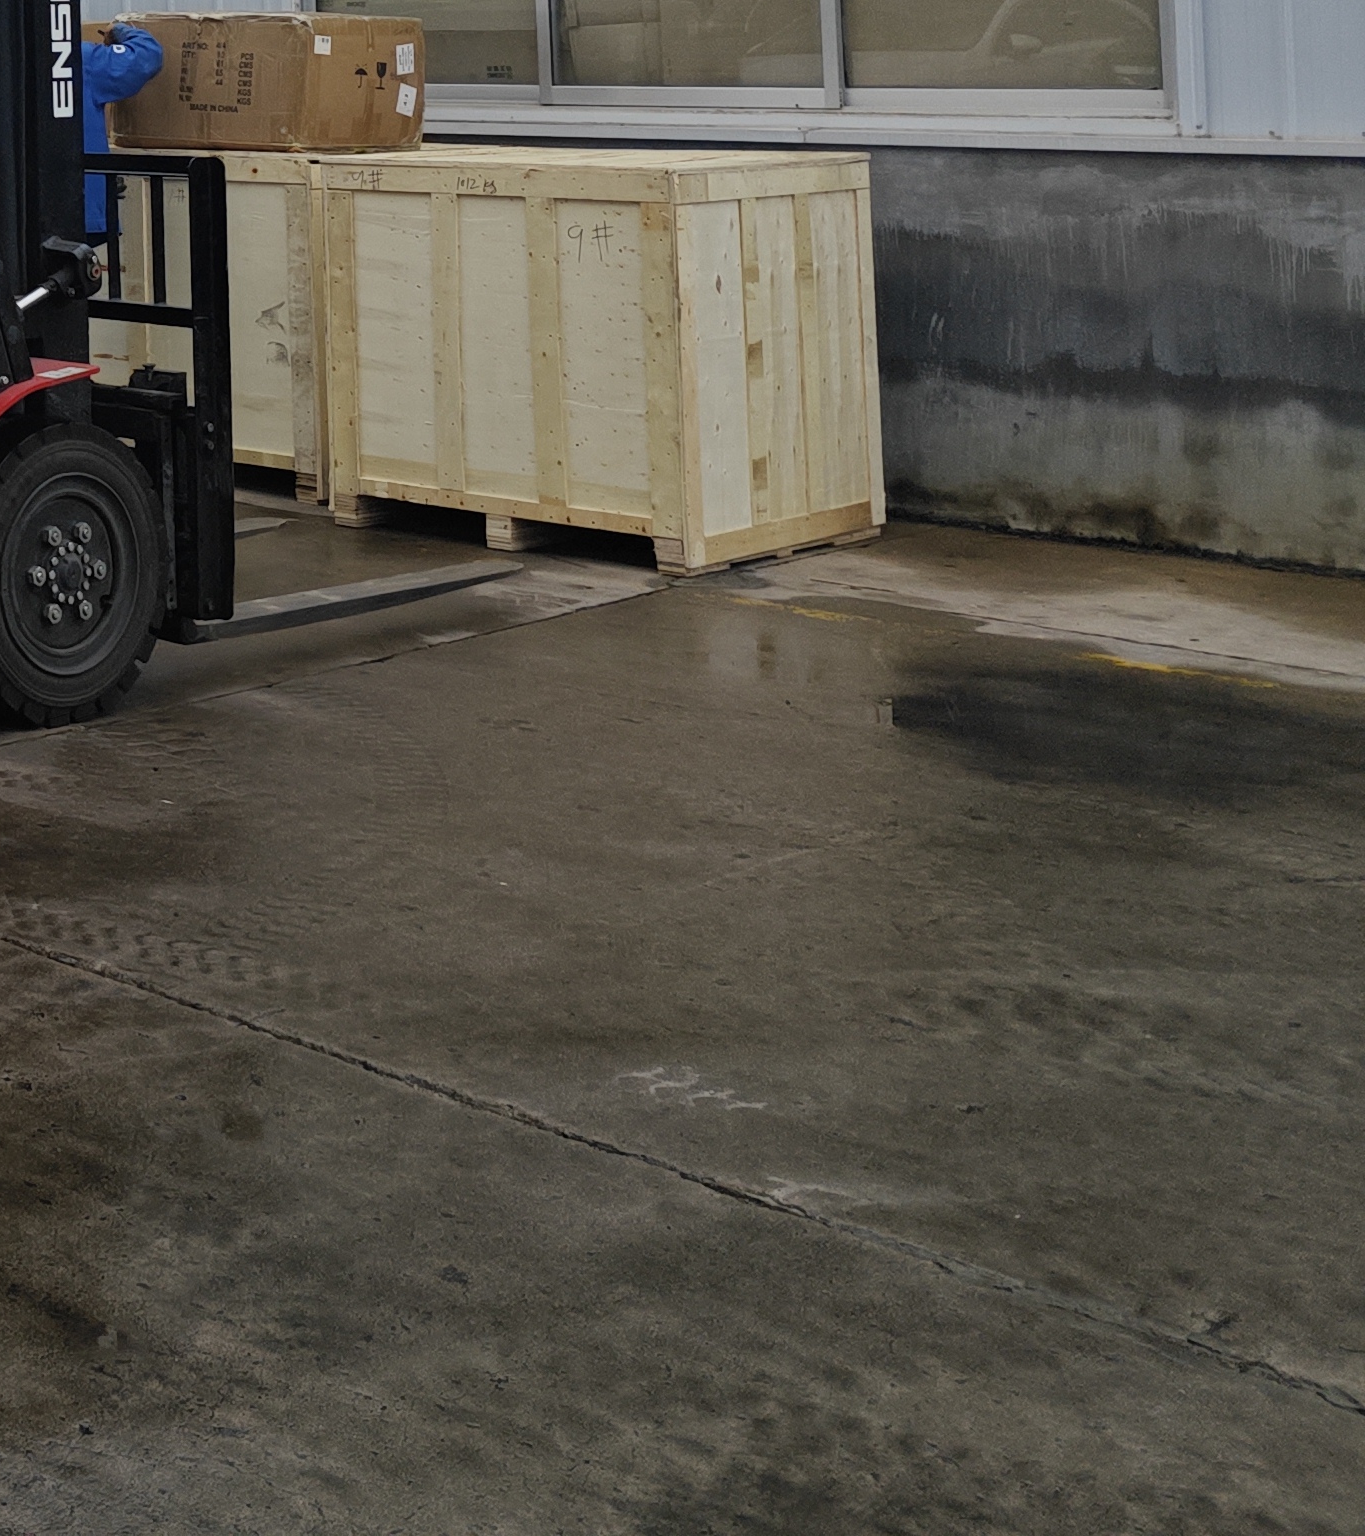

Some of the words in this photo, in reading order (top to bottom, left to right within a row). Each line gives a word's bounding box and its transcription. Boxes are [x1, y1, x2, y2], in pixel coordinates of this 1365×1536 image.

[240, 52, 254, 61] PCS
[237, 88, 252, 97] KGS
[236, 97, 252, 106] KGS
[189, 103, 208, 112] MADE
[210, 104, 217, 112] IN
[217, 105, 239, 114] CHINA
